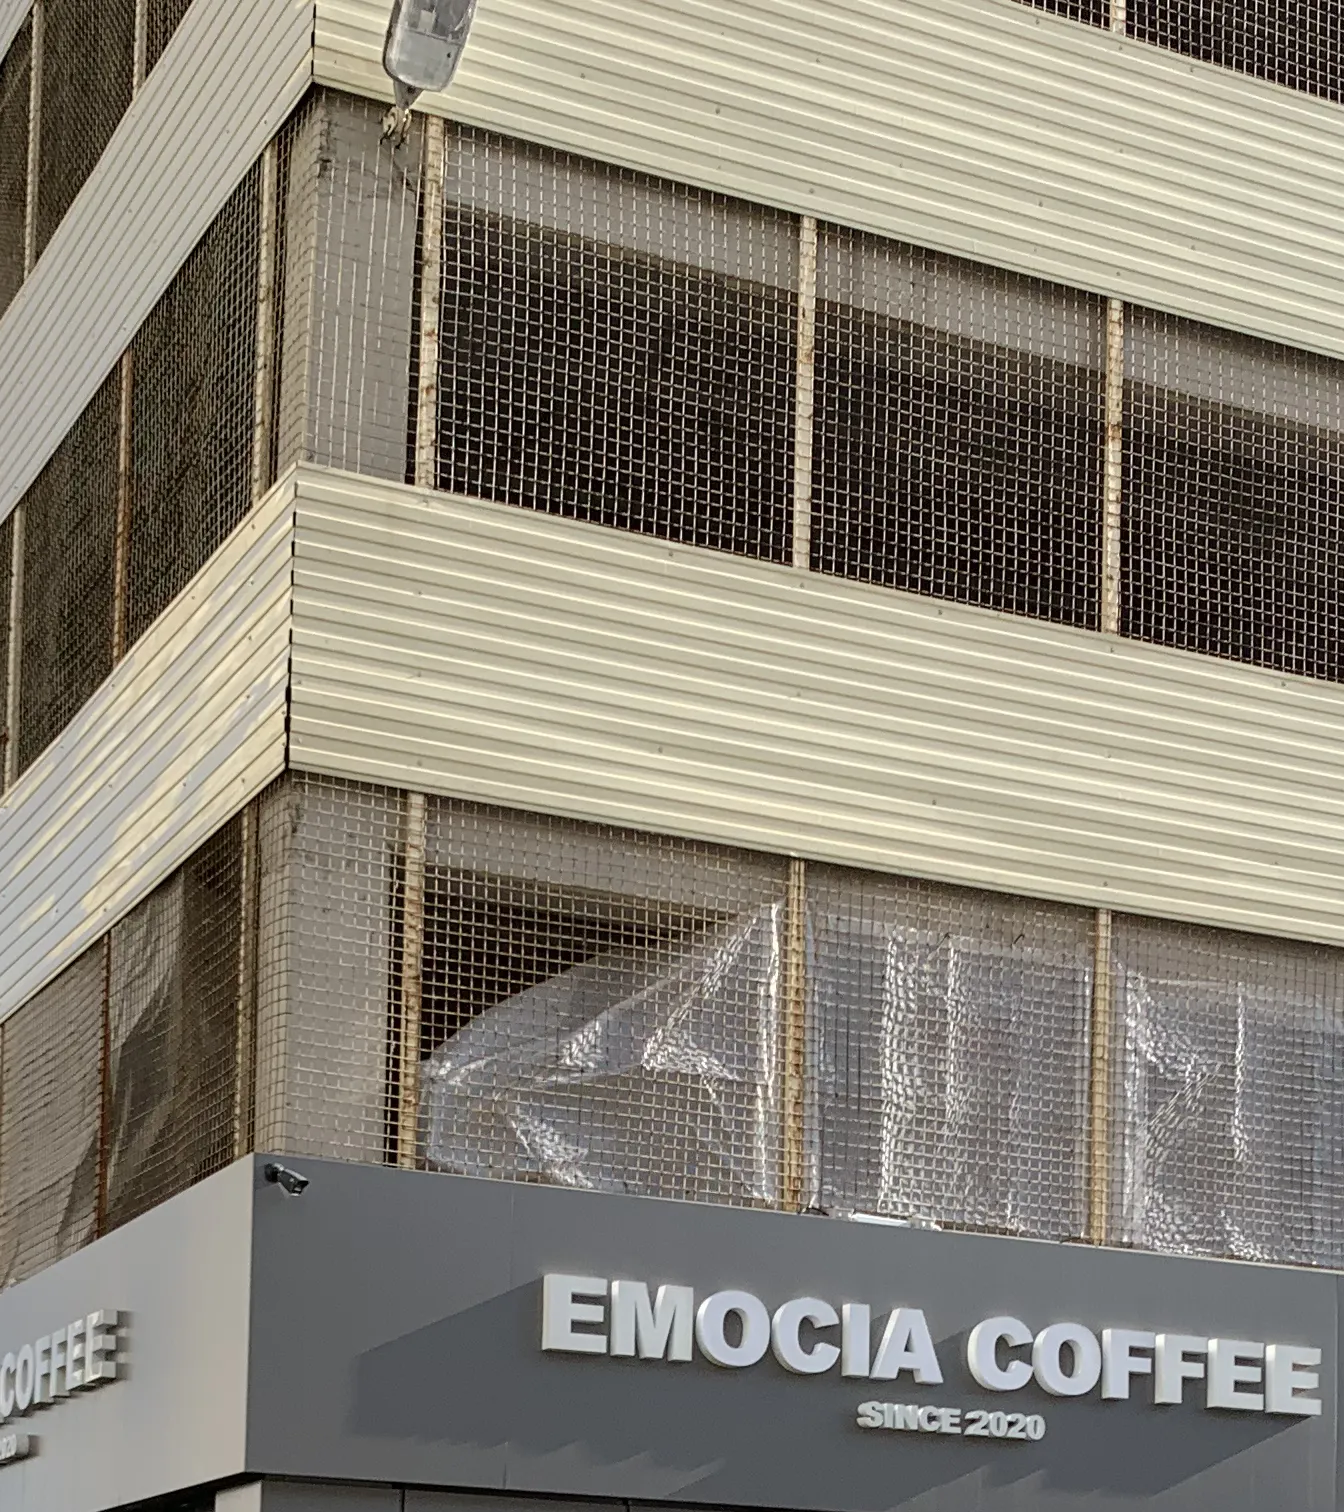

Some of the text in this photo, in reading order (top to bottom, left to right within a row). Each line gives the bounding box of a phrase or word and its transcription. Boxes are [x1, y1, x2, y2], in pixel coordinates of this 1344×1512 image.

[0, 1308, 118, 1418] COFFEE
[540, 1273, 1323, 1417] EMOCIA COFFEE
[856, 1401, 1046, 1441] SINCE 2020
